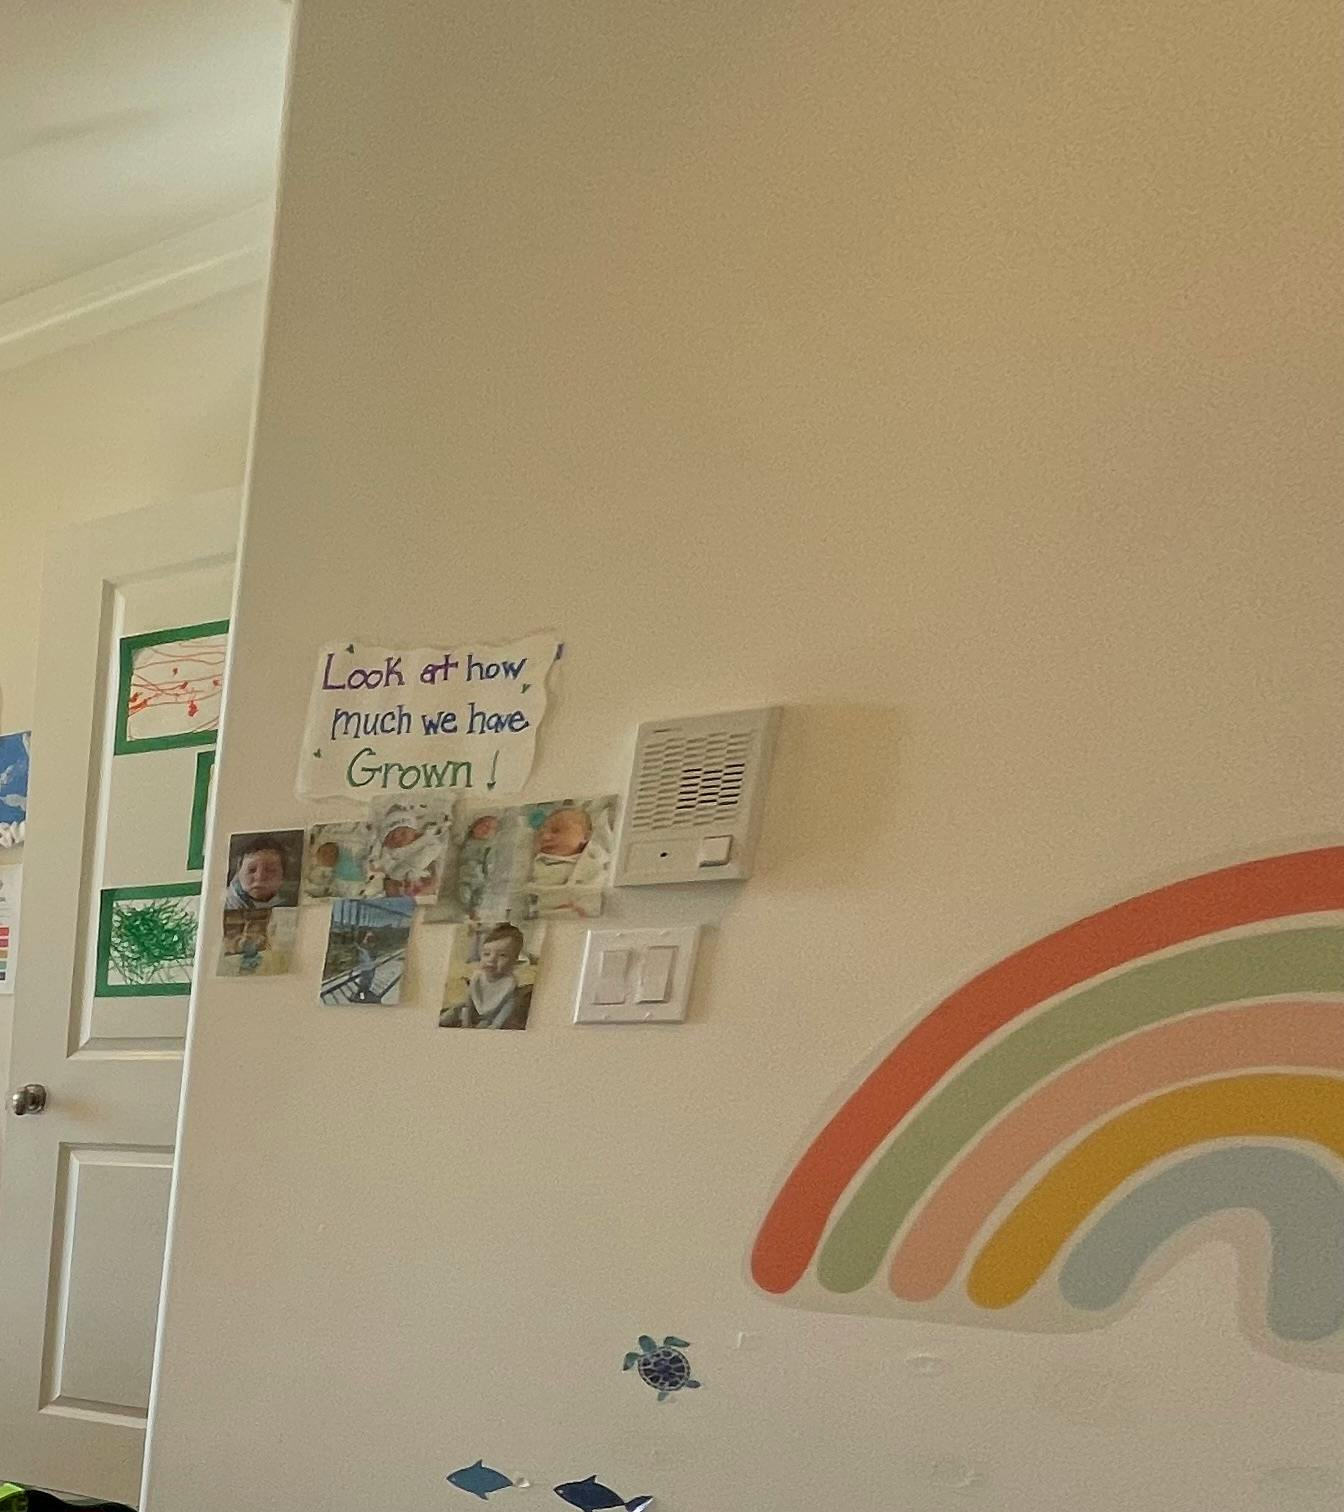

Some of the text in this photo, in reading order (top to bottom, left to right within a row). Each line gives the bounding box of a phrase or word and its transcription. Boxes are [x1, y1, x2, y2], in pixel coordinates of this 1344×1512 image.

[322, 652, 527, 690] Look at how
[331, 702, 530, 741] much we have
[345, 747, 473, 790] Grown
